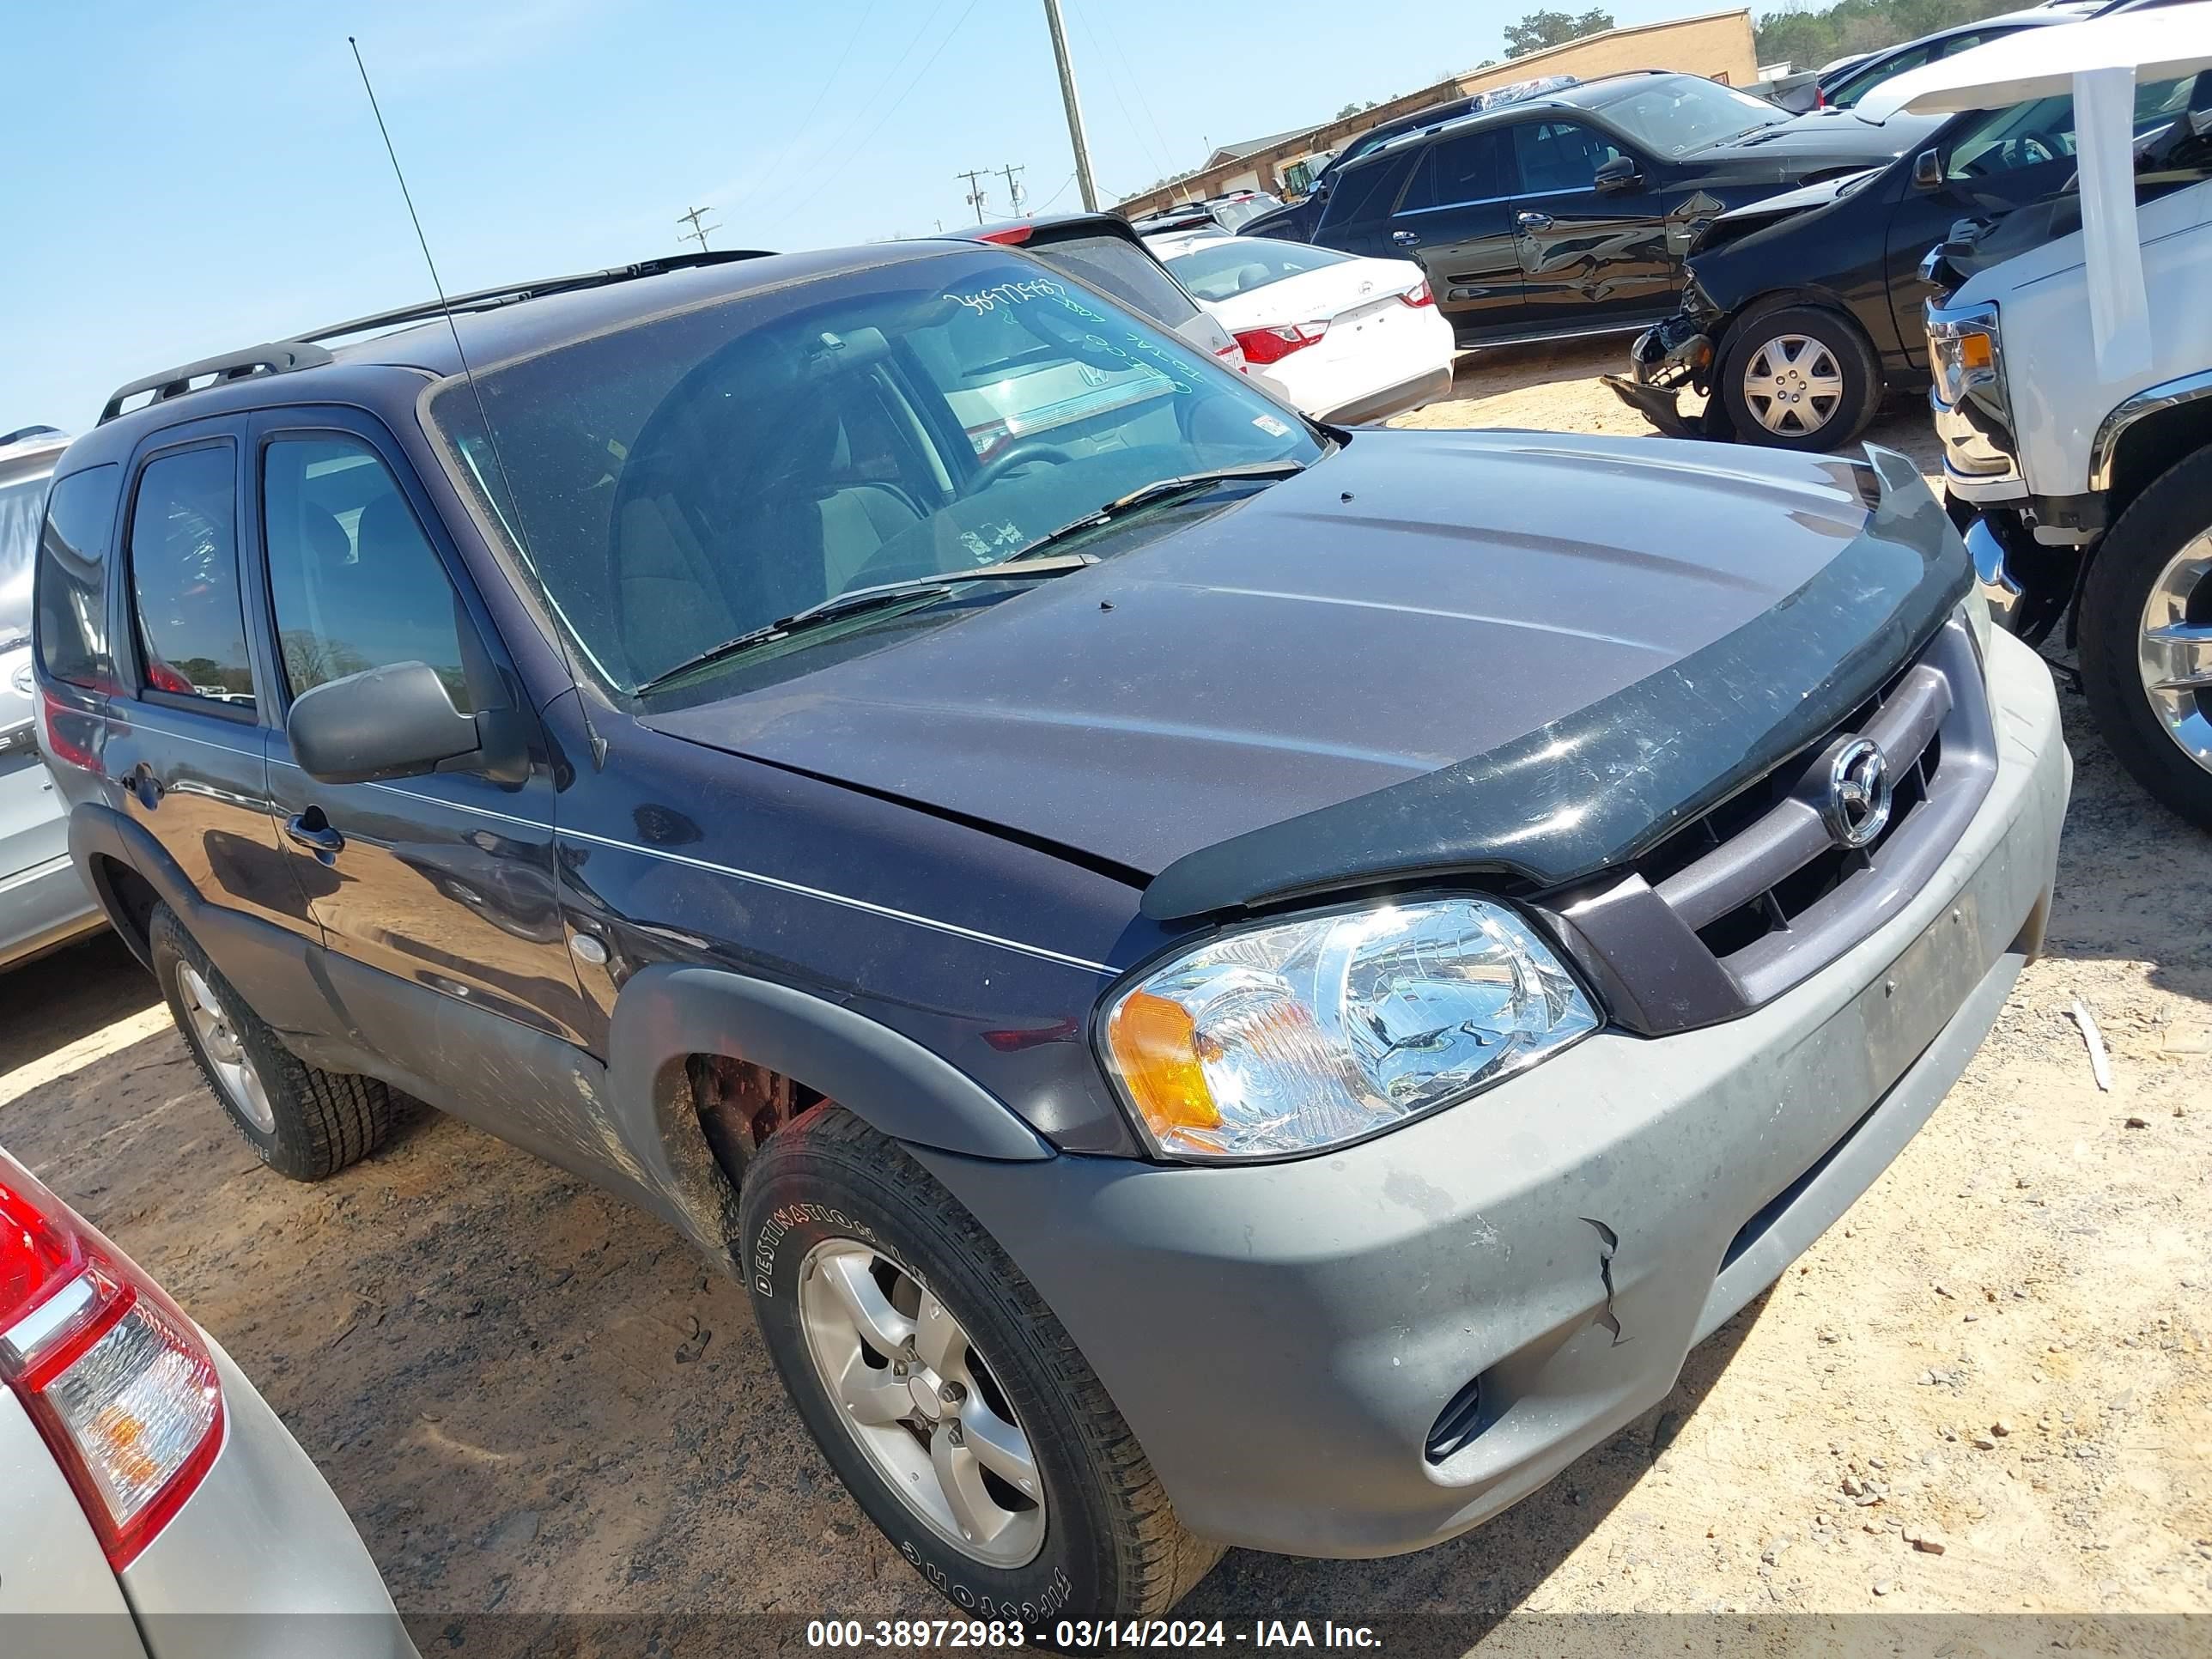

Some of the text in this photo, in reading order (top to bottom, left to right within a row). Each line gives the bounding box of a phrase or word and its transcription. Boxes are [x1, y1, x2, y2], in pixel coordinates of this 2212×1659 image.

[1052, 297, 1107, 324] LOSS
[1085, 334, 1193, 395] GEICO
[1126, 331, 1204, 384] TOTAL
[755, 1202, 877, 1297] DESTINATION
